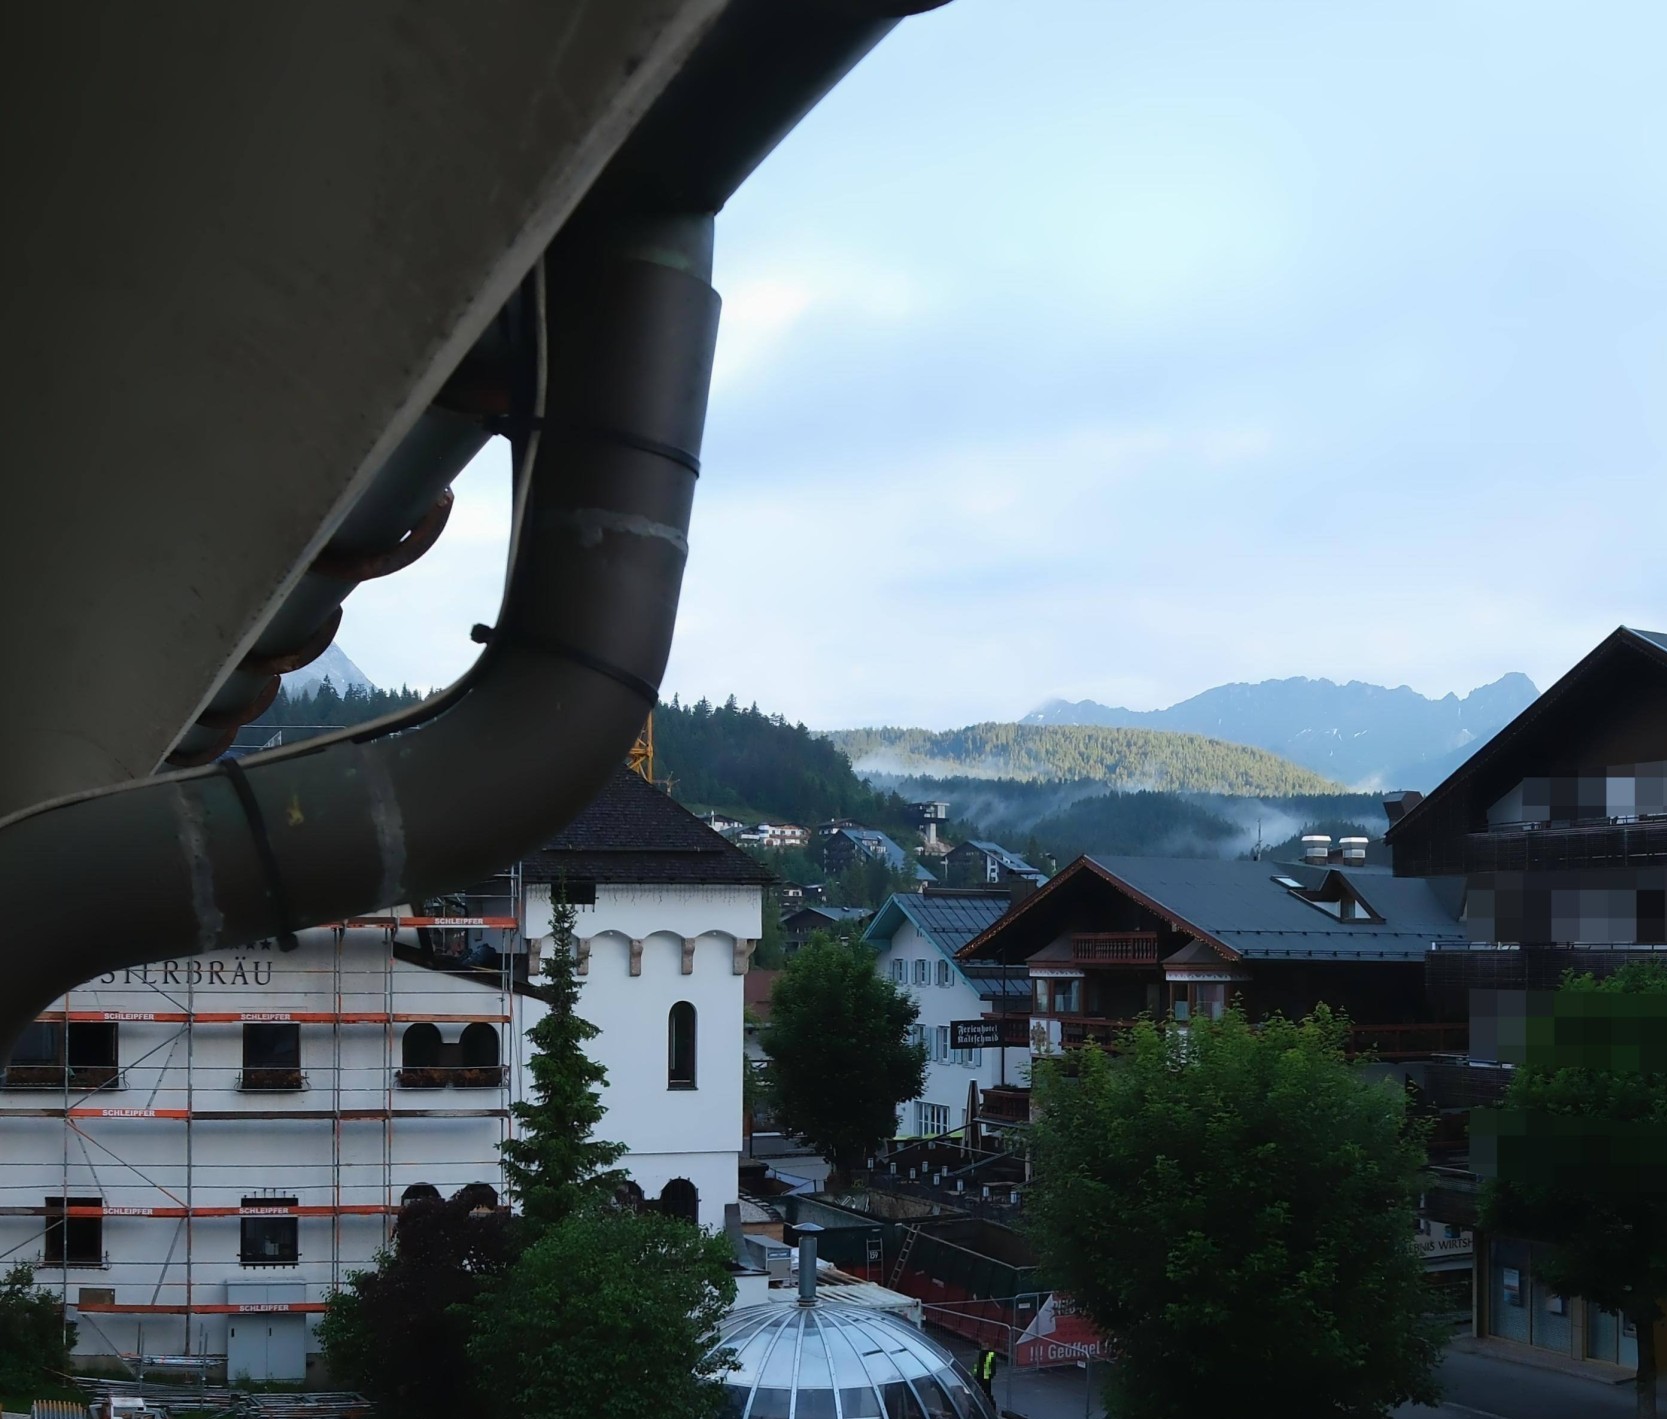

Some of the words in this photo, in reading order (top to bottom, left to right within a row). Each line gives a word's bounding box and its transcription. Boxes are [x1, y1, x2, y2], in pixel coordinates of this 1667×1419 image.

[434, 917, 484, 925] SCHLEIPFER
[104, 1013, 154, 1021] SCHLEIPFER
[241, 1013, 291, 1021] SCHLEIPFER
[102, 1109, 156, 1117] SCHLEIPFER
[103, 1207, 153, 1215] SCHLEIPFER
[238, 1206, 289, 1215] SCHLEIPFER
[239, 1301, 290, 1313] SCHLEIPFER
